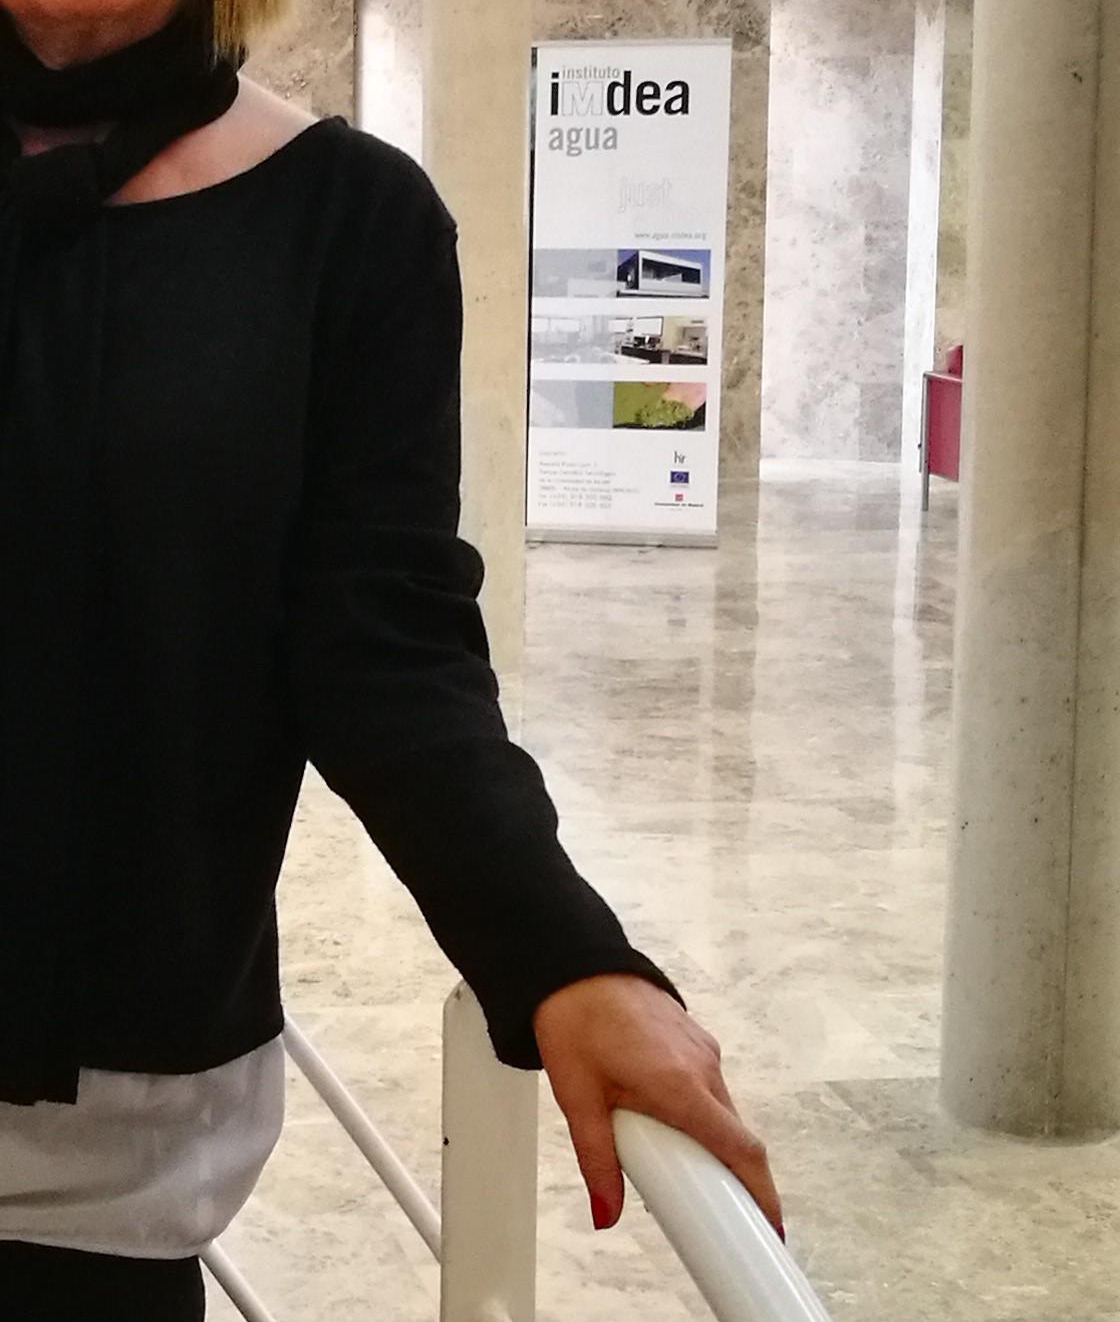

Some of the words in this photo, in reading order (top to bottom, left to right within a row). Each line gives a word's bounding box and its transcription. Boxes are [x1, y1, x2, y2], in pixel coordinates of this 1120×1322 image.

[562, 65, 621, 80] instituto
[550, 70, 691, 117] iMdea
[548, 126, 619, 158] agua
